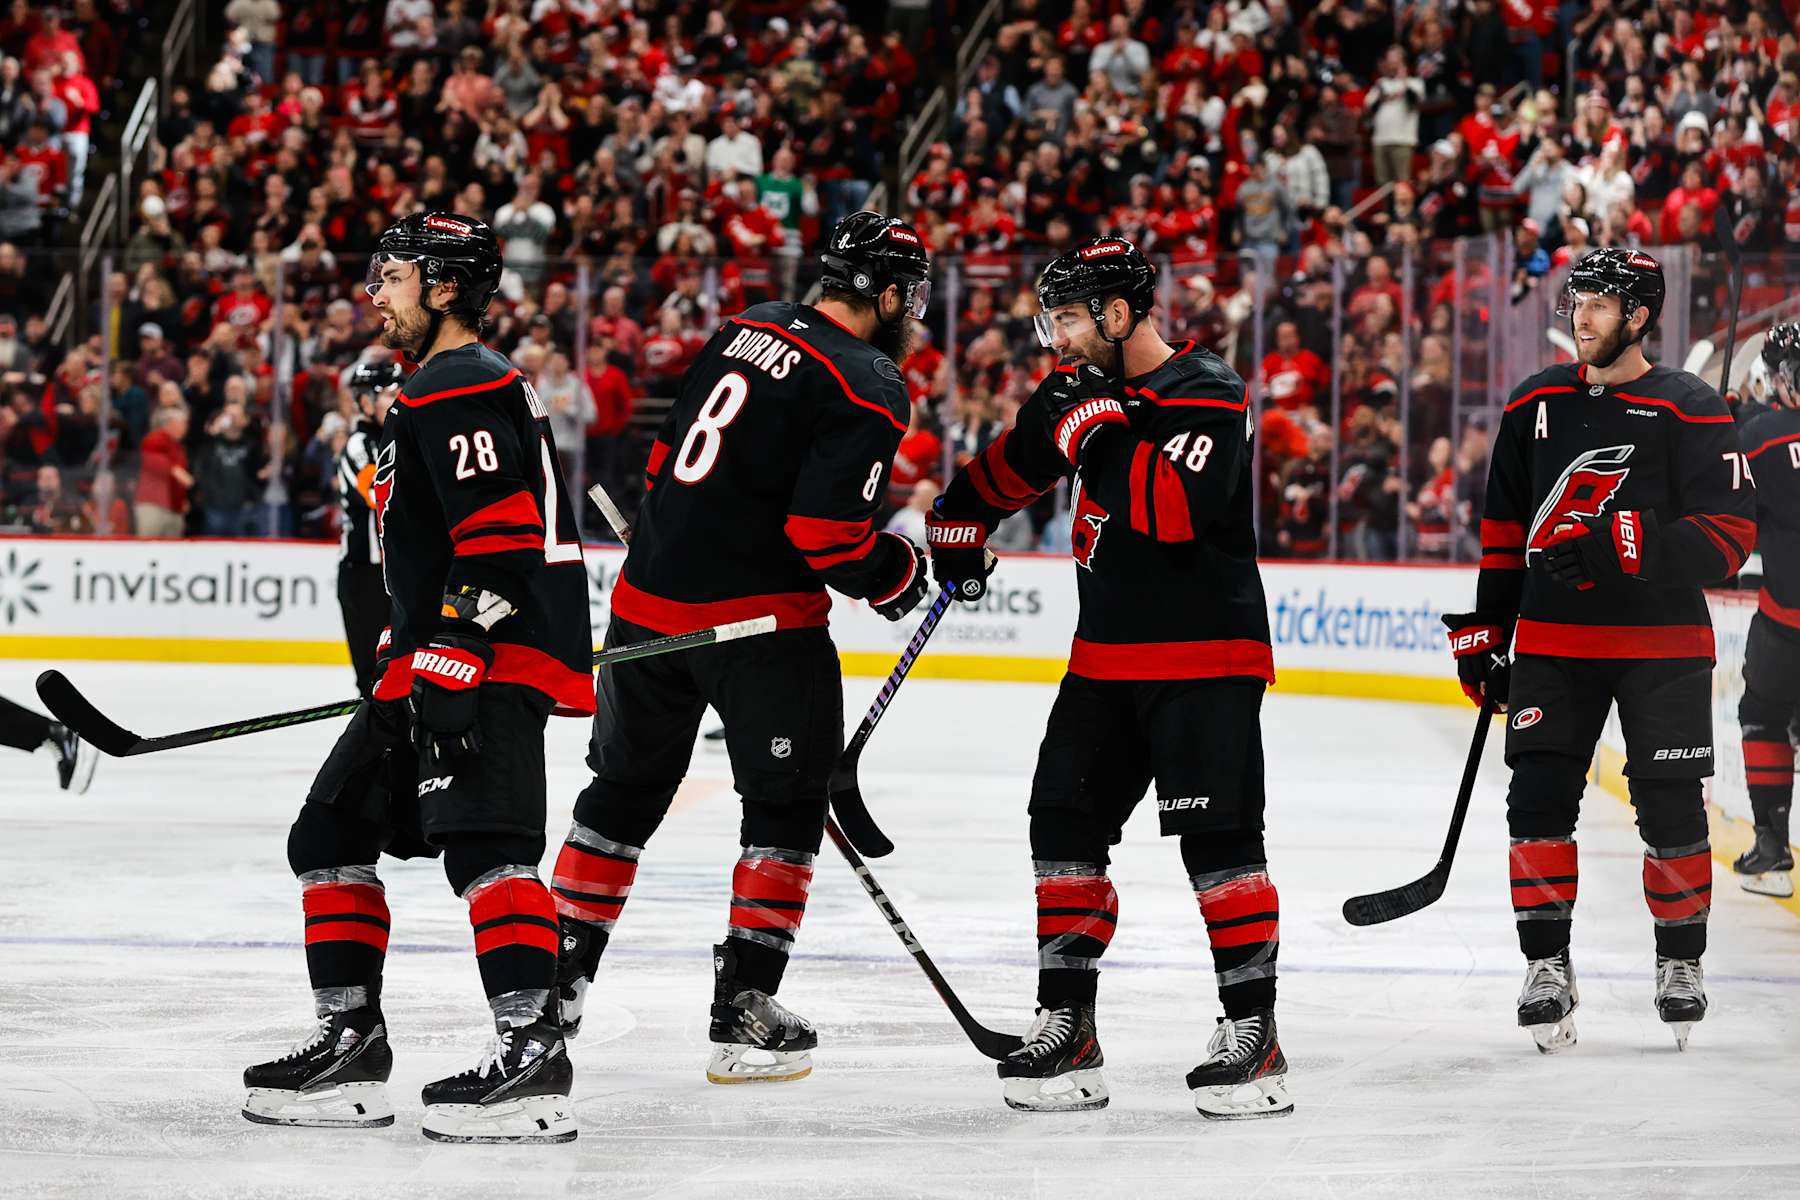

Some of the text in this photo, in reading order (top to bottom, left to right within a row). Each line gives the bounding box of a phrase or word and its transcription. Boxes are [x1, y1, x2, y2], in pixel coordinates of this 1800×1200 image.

[431, 218, 471, 234] Lenovo
[838, 233, 851, 249] 8
[891, 230, 918, 243] Lenovo
[1085, 244, 1121, 257] Lenovo
[721, 327, 802, 381] BURNS
[672, 370, 750, 486] 8
[1058, 398, 1124, 458] WARRIOR
[1534, 400, 1549, 440] A
[1626, 408, 1658, 417] NUCOR
[448, 429, 499, 481] 28
[1162, 430, 1214, 473] 48
[862, 460, 884, 502] 8
[1618, 510, 1638, 560] UER
[73, 559, 318, 620] invisalign
[1276, 587, 1444, 653] ticketmaste
[1451, 629, 1490, 653] UER
[410, 650, 478, 684] RRIOR
[1652, 746, 1713, 761] BAUER
[855, 865, 925, 955] CCM
